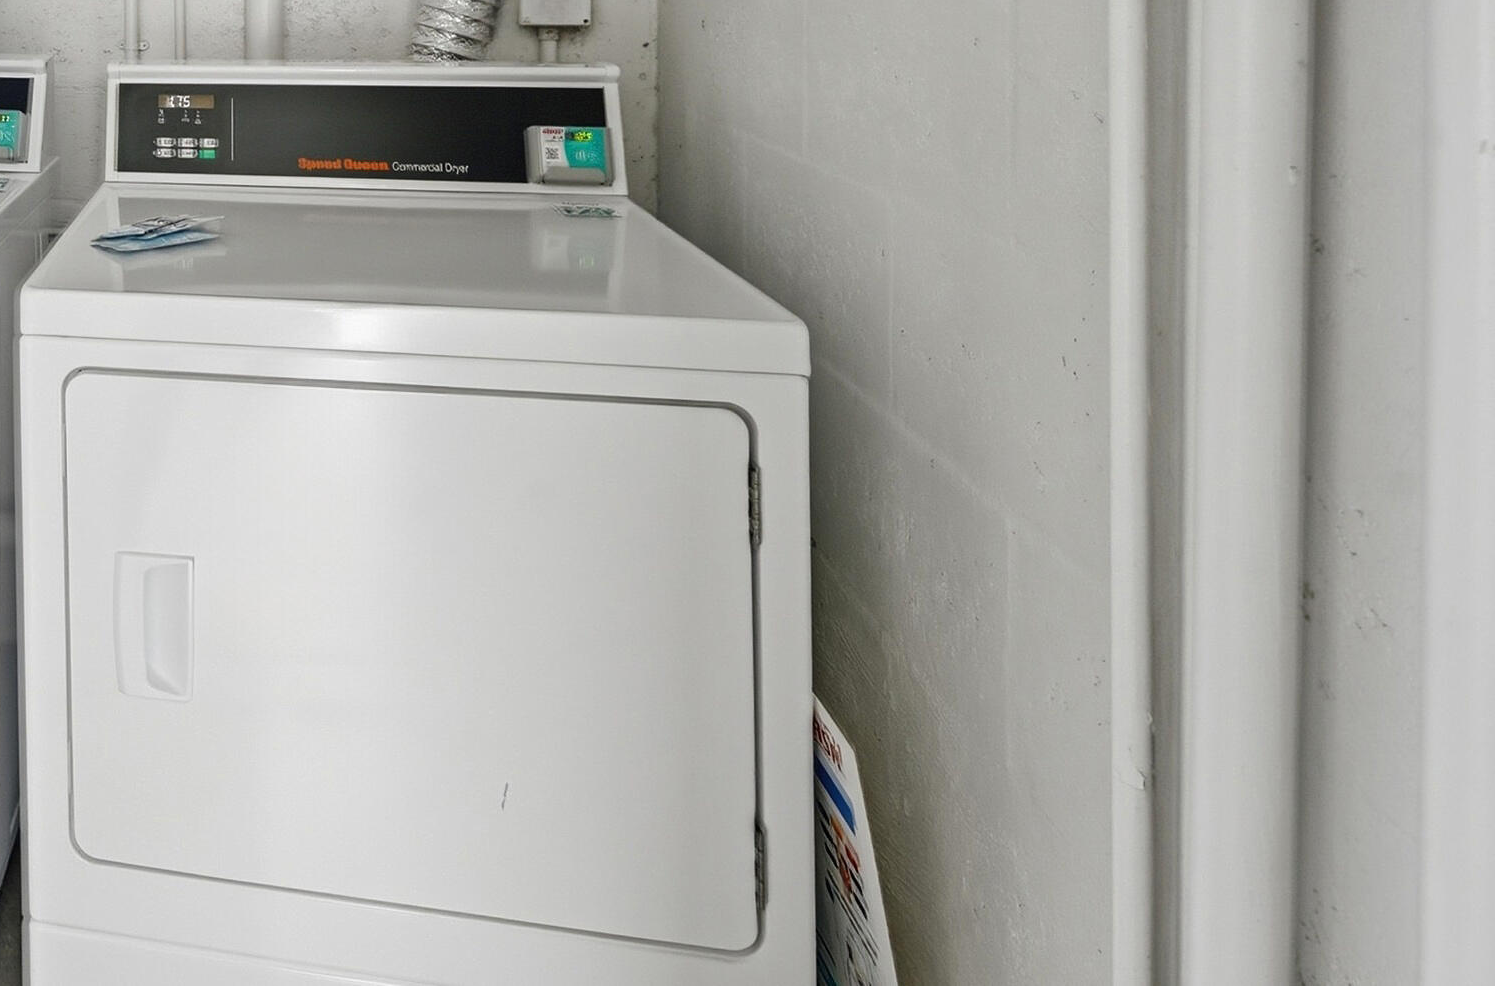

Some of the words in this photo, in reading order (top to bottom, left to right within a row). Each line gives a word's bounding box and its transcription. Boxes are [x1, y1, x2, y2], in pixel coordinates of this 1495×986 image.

[298, 157, 341, 172] Speed
[344, 158, 389, 171] Queen
[392, 161, 443, 173] Commercial
[445, 163, 469, 175] Dryer
